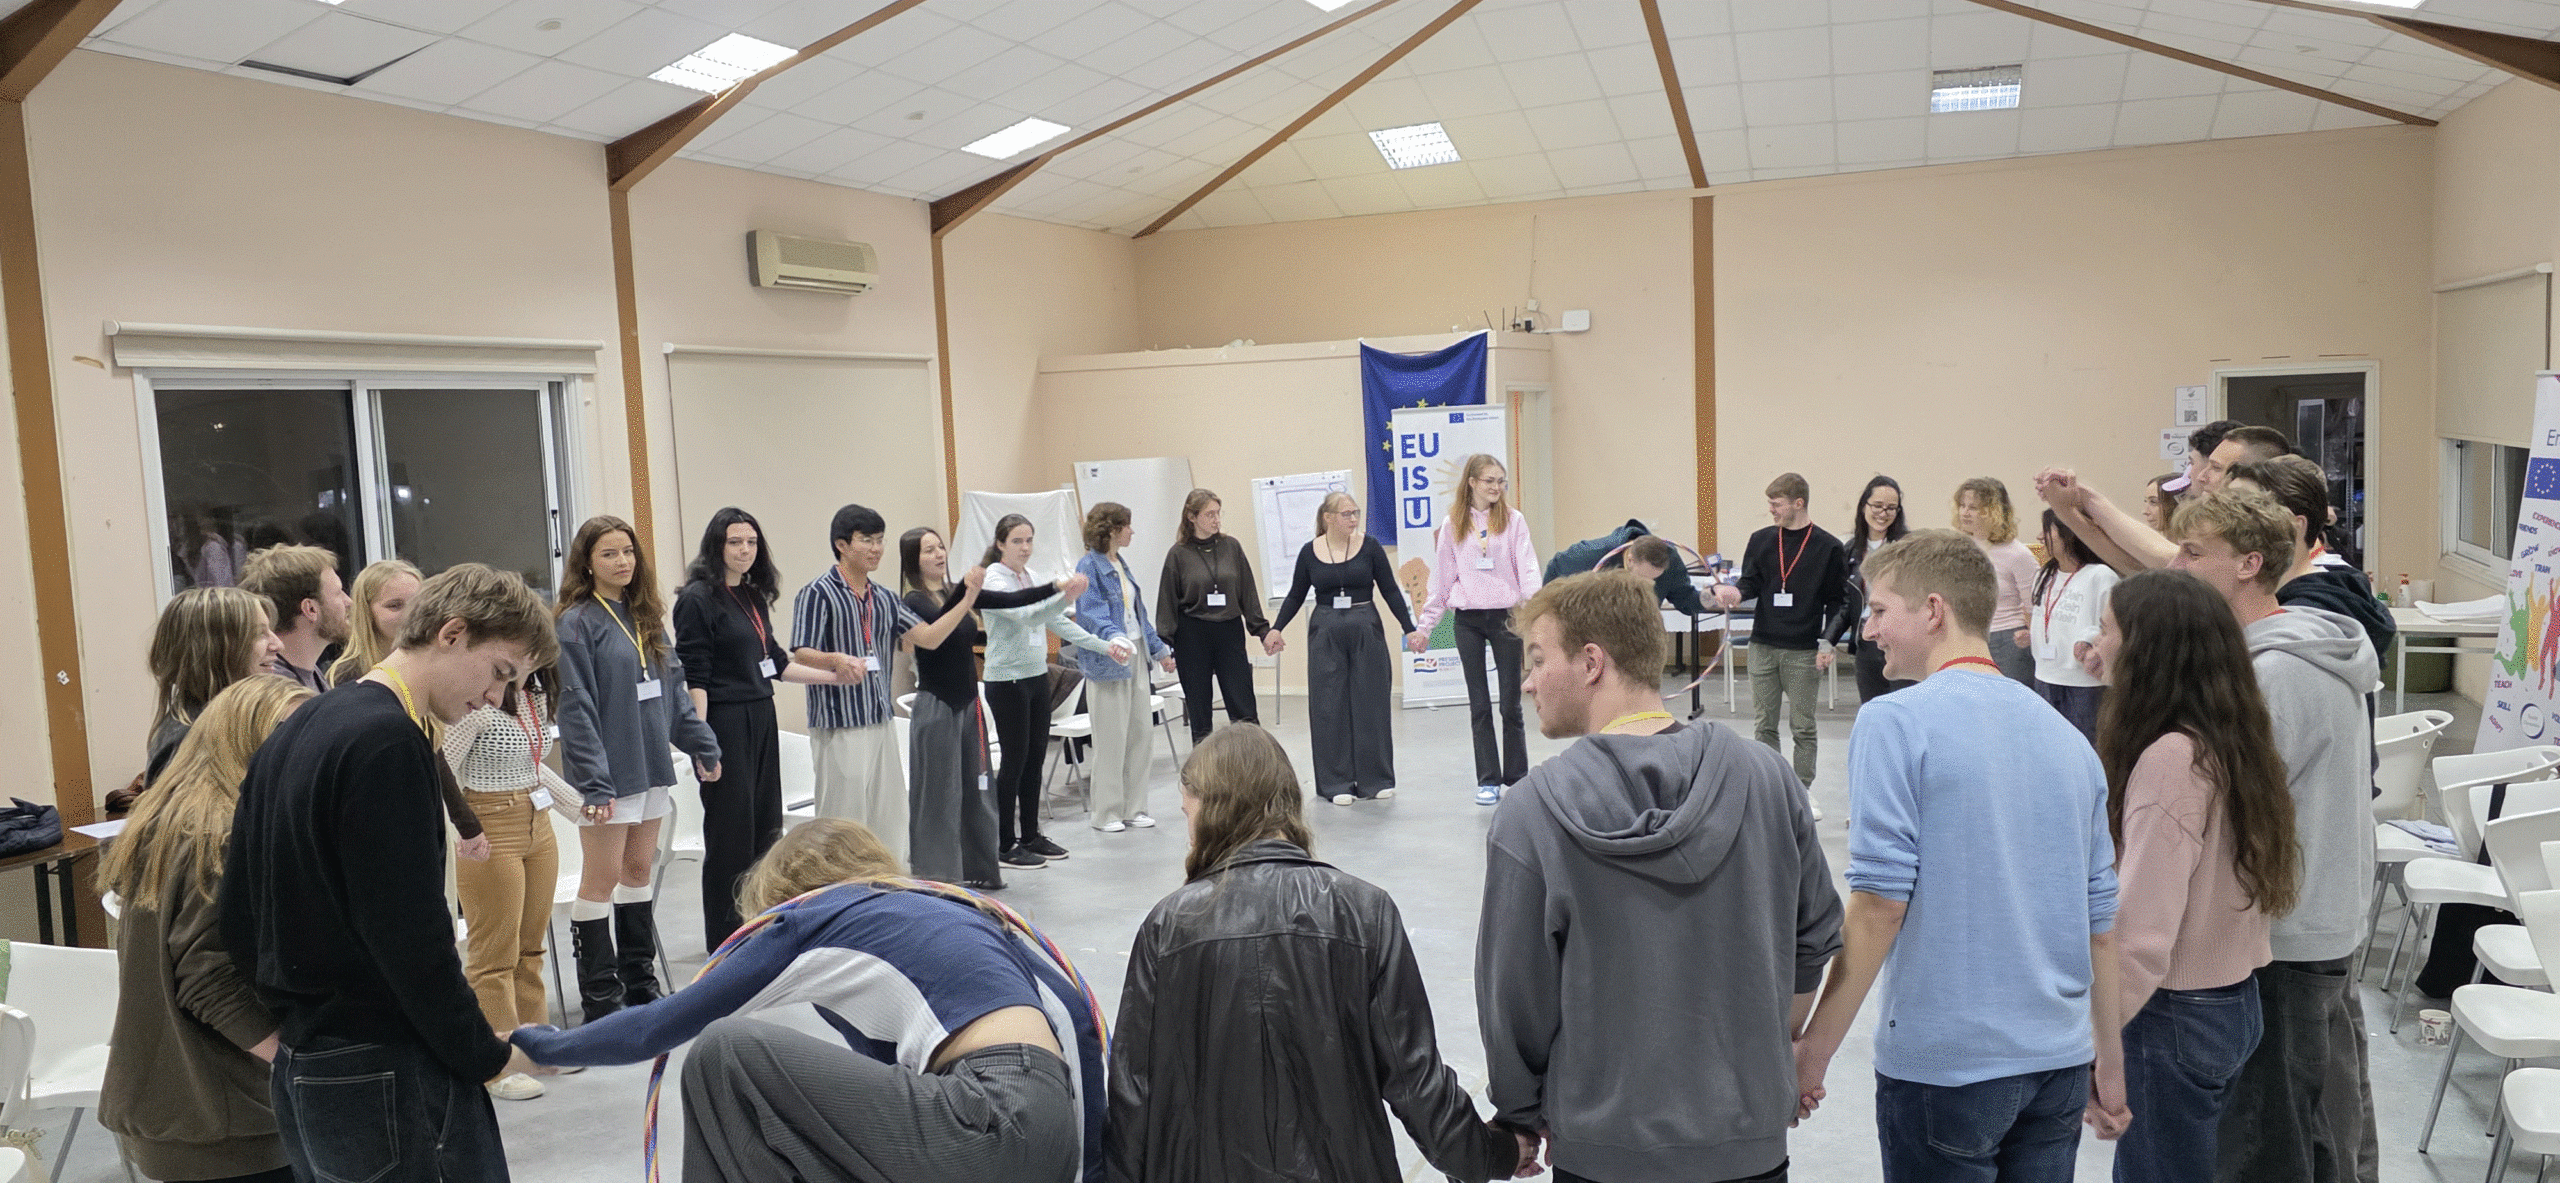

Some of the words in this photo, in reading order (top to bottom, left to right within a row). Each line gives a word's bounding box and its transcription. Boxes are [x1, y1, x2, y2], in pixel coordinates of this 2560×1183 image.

[1400, 432, 1439, 459] EU
[1402, 465, 1429, 491] IS
[1405, 498, 1429, 526] U
